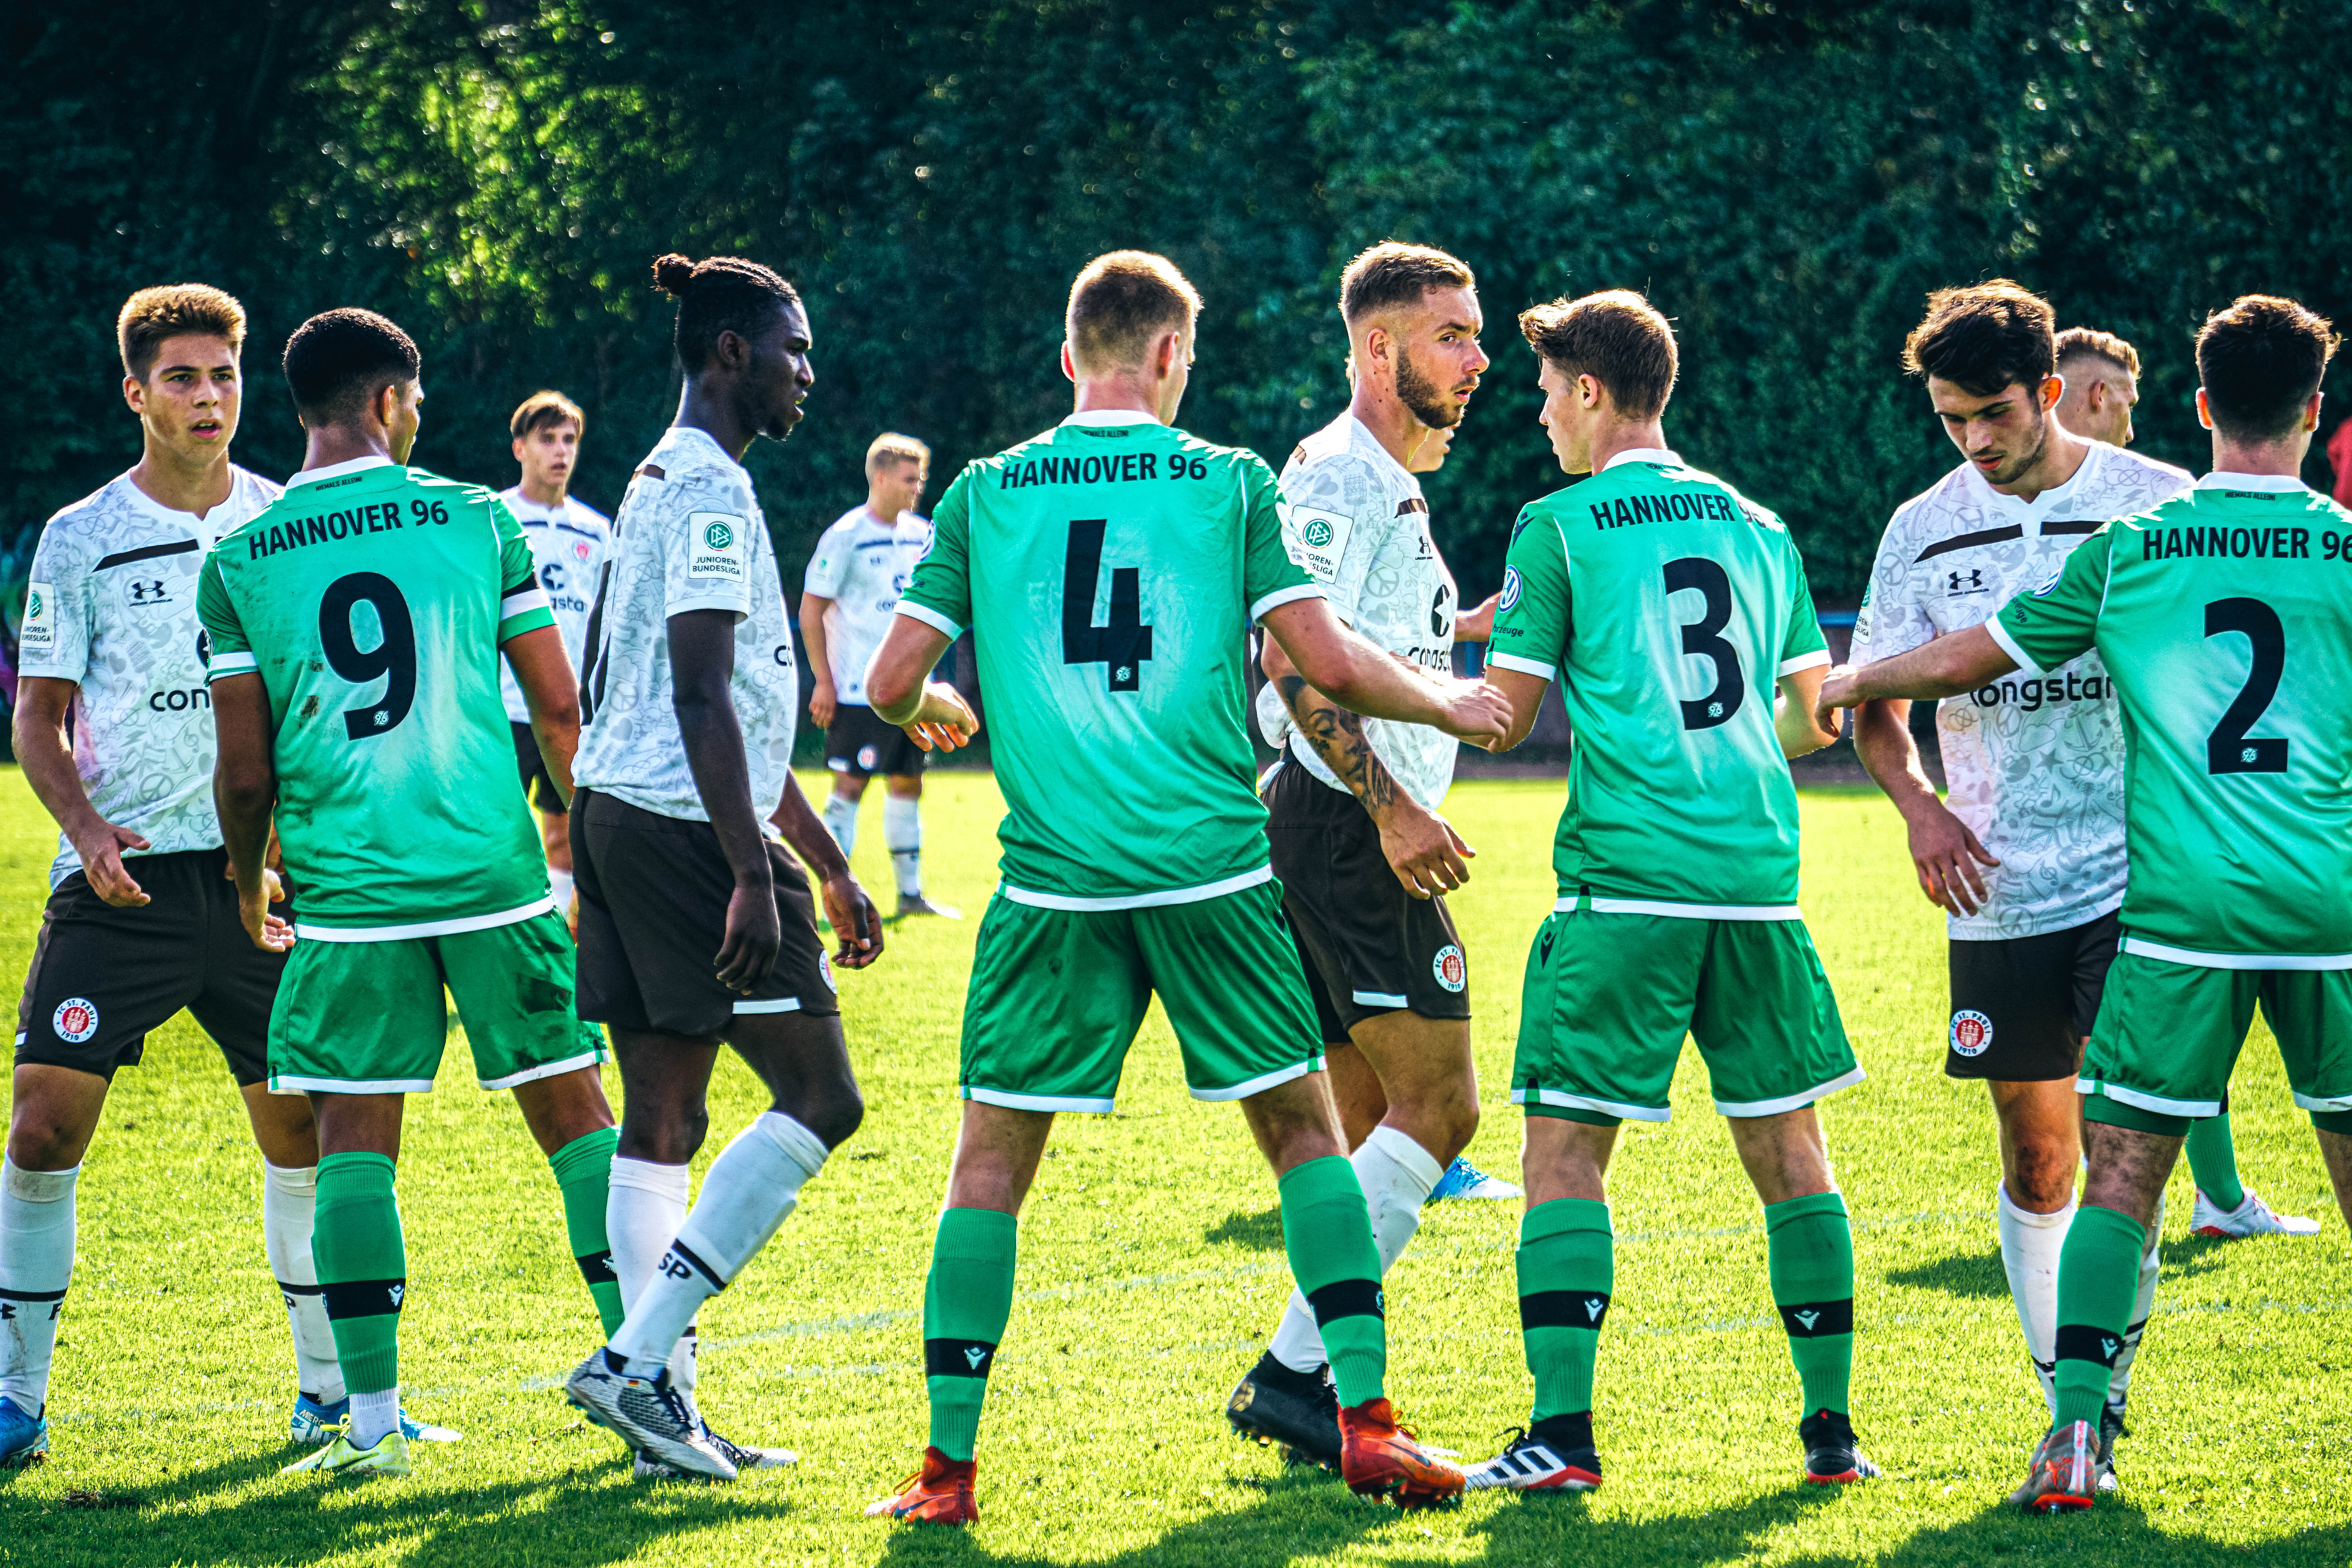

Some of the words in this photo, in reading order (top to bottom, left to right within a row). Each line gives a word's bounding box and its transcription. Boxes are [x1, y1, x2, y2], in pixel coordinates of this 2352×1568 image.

[315, 481, 340, 491] NIEMALS
[1000, 453, 1157, 490] HANNOVER
[1169, 454, 1207, 480] 96
[1589, 493, 1735, 530] HANNOVER
[249, 502, 403, 561] HANNOVER
[410, 499, 448, 526] 96
[2143, 527, 2309, 561] HANNOVER
[2321, 531, 2352, 563] 96
[692, 565, 740, 575] BUNDESLIGA
[695, 557, 739, 566] JUNIOREN-
[1063, 519, 1152, 692] 4
[318, 572, 416, 741] 9
[1662, 557, 1744, 730] 3
[150, 689, 210, 712] con
[2204, 597, 2288, 775] 2
[61, 1031, 79, 1041] 1910
[1958, 1046, 1977, 1055] 1910
[659, 1253, 692, 1279] SP
